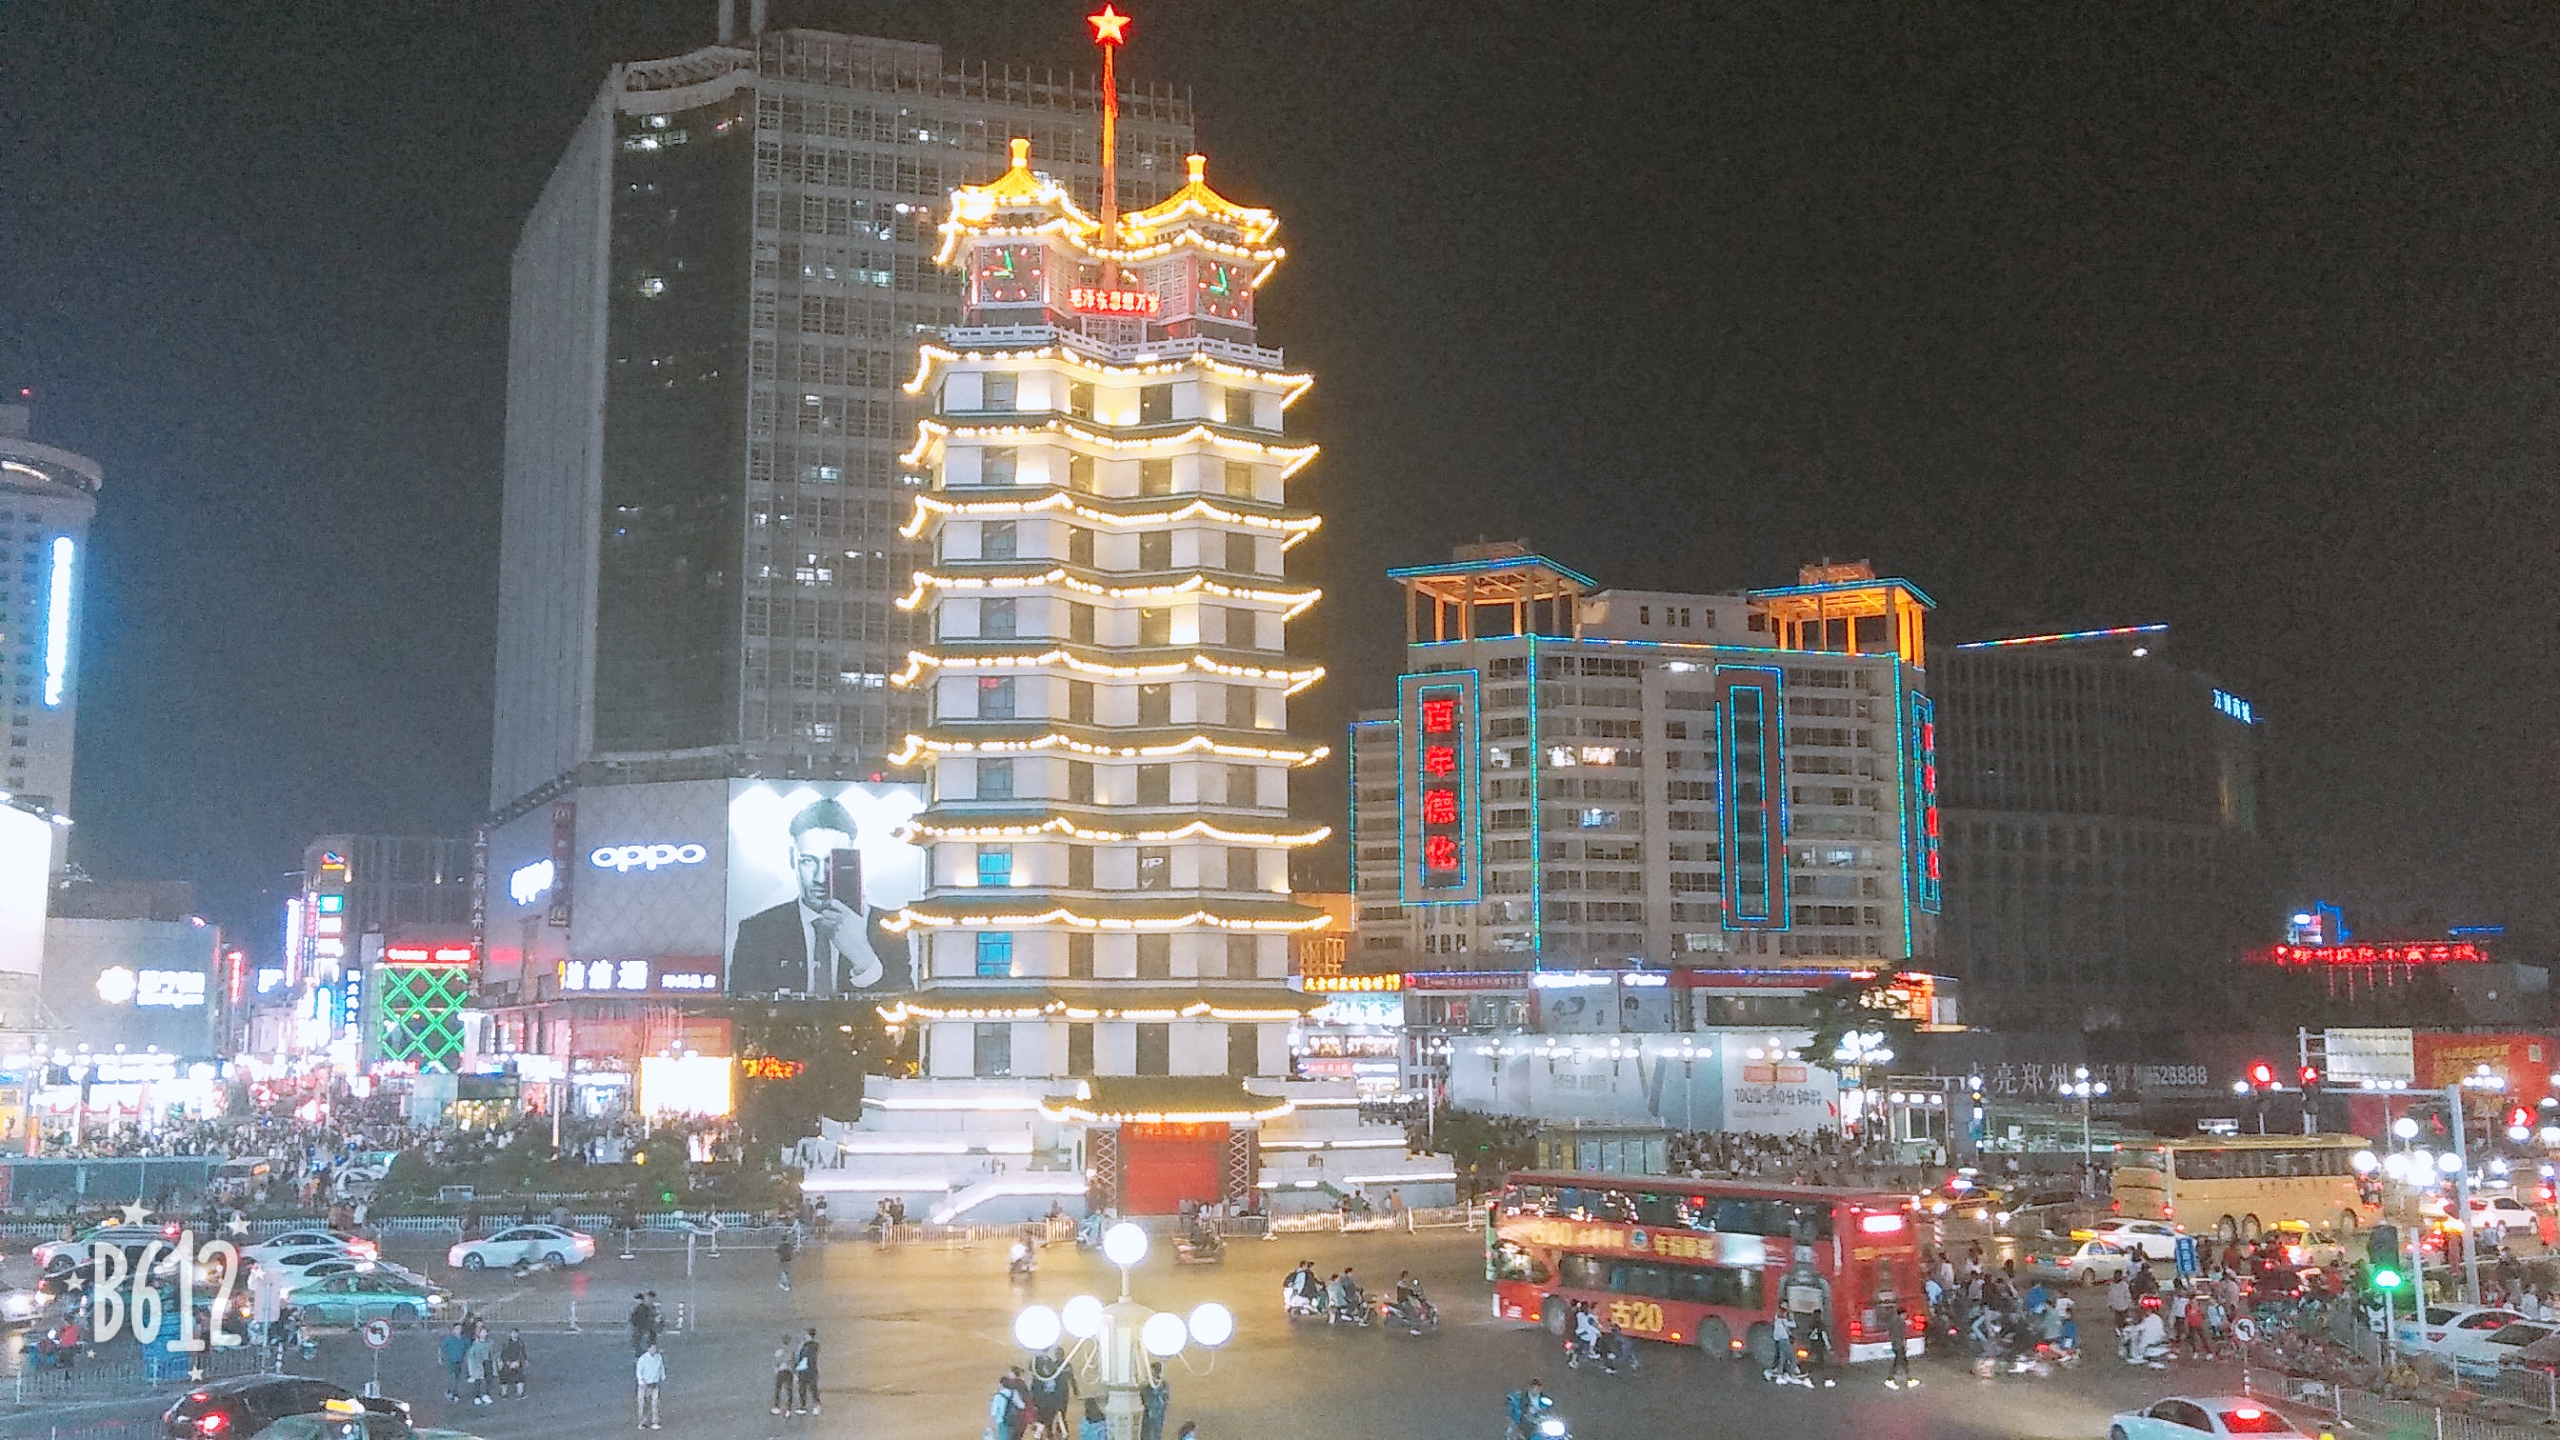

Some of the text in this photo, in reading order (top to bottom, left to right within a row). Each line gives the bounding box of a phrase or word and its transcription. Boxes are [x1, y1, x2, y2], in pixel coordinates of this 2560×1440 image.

[1070, 288, 1160, 313] 毛泽东思想万岁
[1609, 1300, 1664, 1333] 古20
